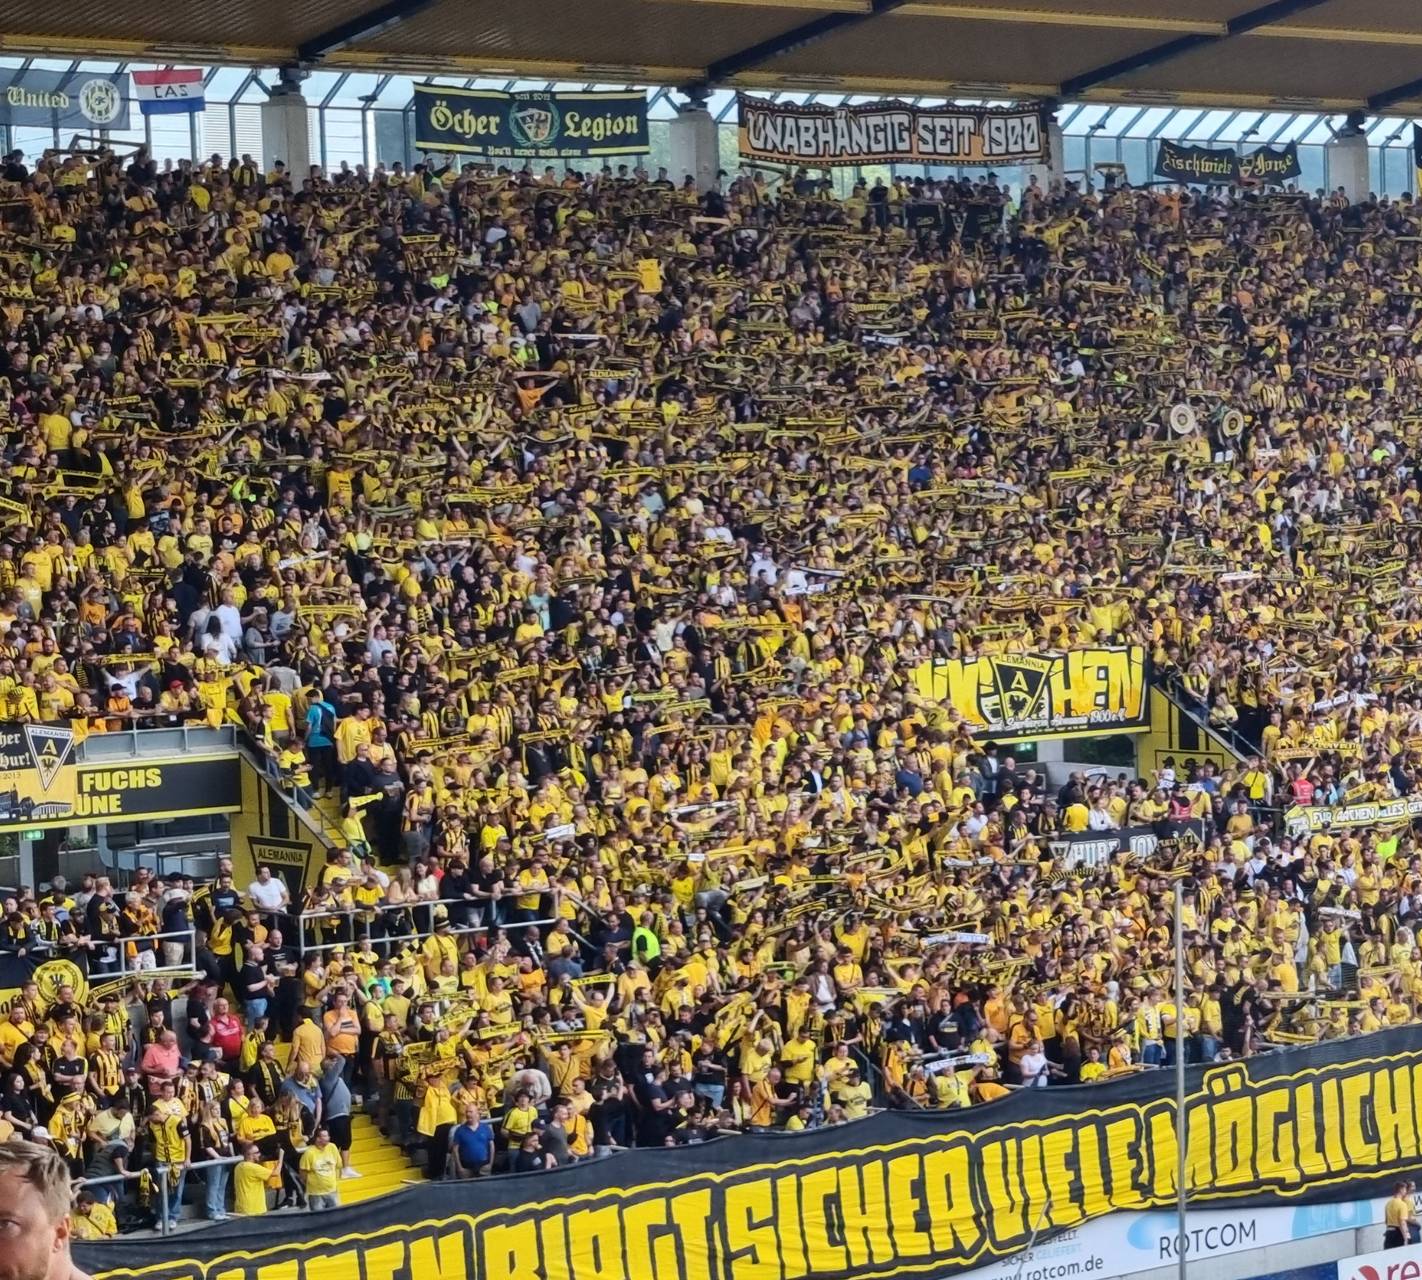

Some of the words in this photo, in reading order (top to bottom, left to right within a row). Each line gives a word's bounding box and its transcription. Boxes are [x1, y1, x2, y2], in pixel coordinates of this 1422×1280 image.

[7, 86, 69, 108] United
[430, 100, 499, 138] Öcher
[564, 111, 639, 141] Legion
[748, 107, 910, 156] UNABHÄNGIG
[916, 114, 975, 155] SEIT
[982, 114, 1041, 155] 1900
[82, 768, 162, 792] FUCHS
[258, 848, 303, 862] ALEMANNIA
[726, 1146, 976, 1272] SICHER
[981, 1118, 1147, 1244] VIELE
[1158, 1218, 1257, 1261] ROTCOM
